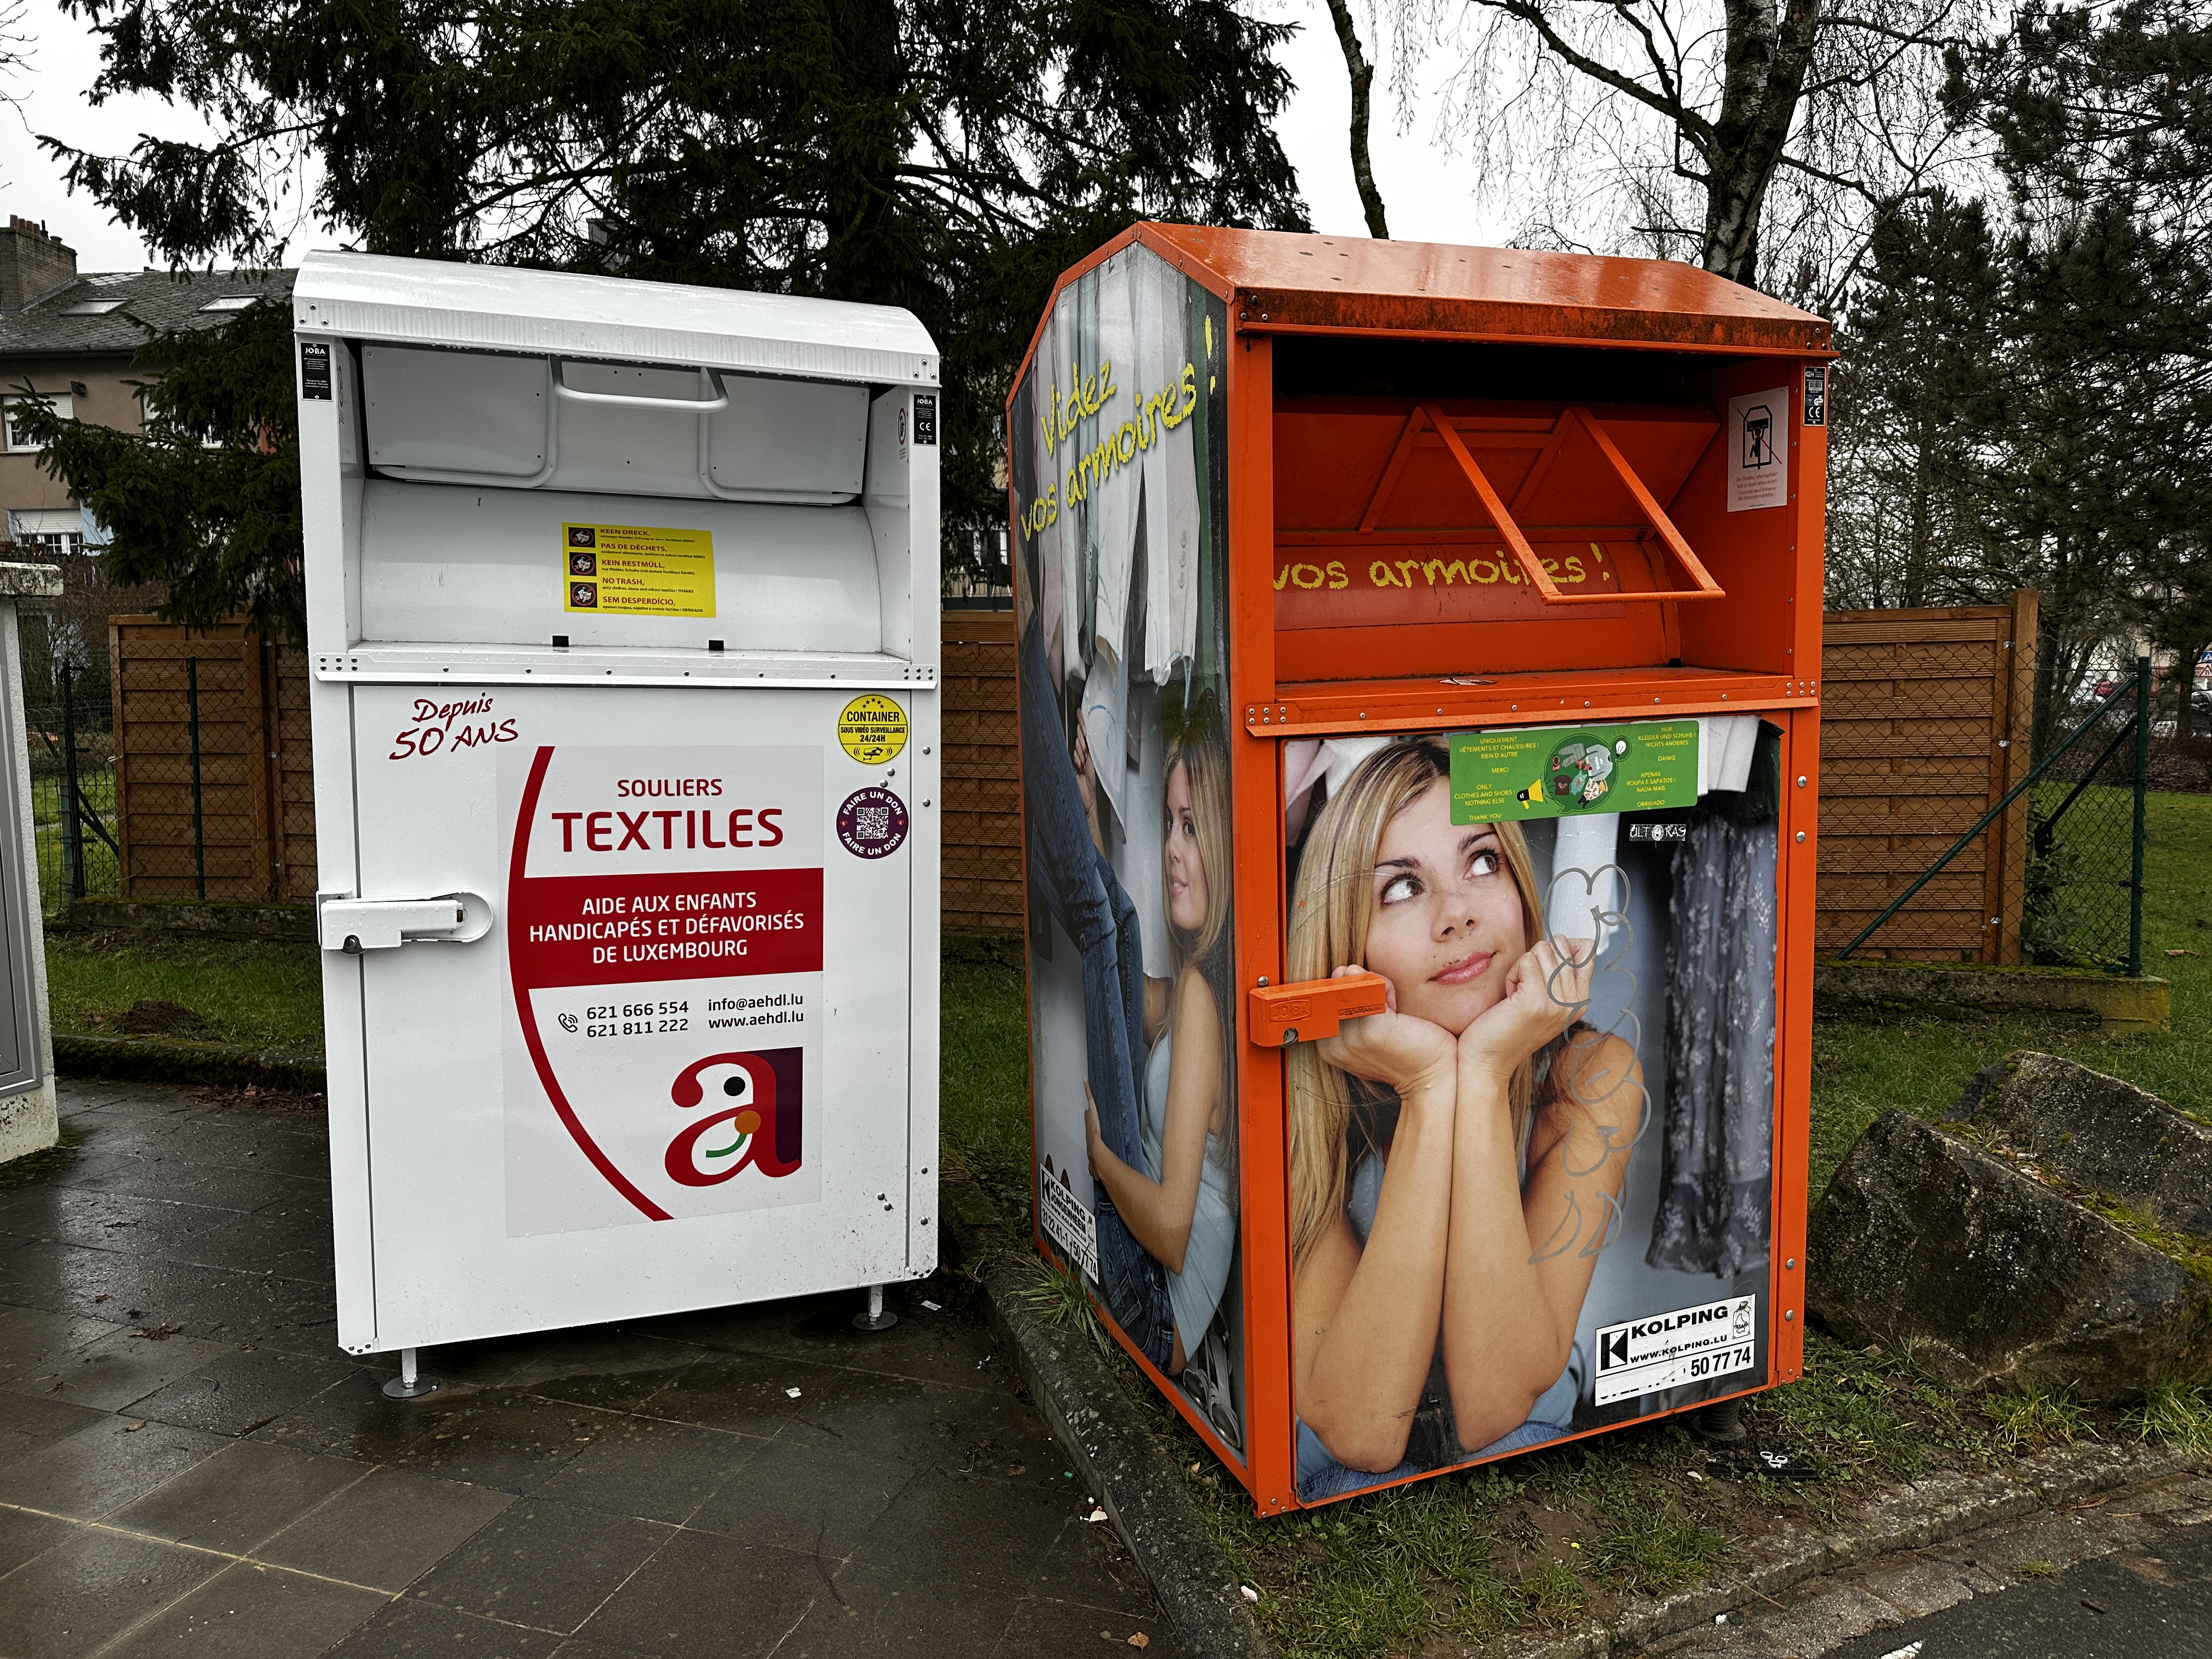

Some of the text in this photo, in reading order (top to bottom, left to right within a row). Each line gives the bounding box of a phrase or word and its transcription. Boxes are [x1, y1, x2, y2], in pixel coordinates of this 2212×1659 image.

[1041, 360, 1116, 457] Videz
[1021, 483, 1057, 542] vos
[622, 561, 665, 569] RESTMÜLL,
[1273, 560, 1349, 590] vos
[622, 597, 675, 606] DESPERDÍCIO,
[412, 692, 493, 731] Depuis
[847, 711, 900, 722] CONTAINER
[389, 718, 518, 760] 50 ANS
[855, 725, 870, 733] VIDÉO
[860, 734, 885, 742] 24/24H
[617, 778, 723, 798] SOULIERS
[843, 791, 903, 816] FAIRE UN DON
[551, 808, 783, 853] TEXTILES
[842, 832, 902, 855] FAIRE UN DON
[582, 891, 757, 916] AIDE AUX ENFANTS
[529, 909, 804, 943] HANDICAPÉS ET DÉFAVORISÉS
[592, 938, 748, 964] DE LUXEMBOURG
[586, 1001, 689, 1020] 621 666 554
[708, 994, 804, 1012] info@aehdl.lu
[586, 1018, 689, 1038] 621 811 222
[708, 1011, 804, 1029] www.aehdl.lu
[1050, 1178, 1086, 1222] KOLPING
[1051, 1192, 1086, 1234] JONGENHEEM
[1632, 1306, 1728, 1340] KOLPING
[1630, 1334, 1728, 1364] WWW.KOLPING.LU
[1691, 1346, 1751, 1376] 50 77 74
